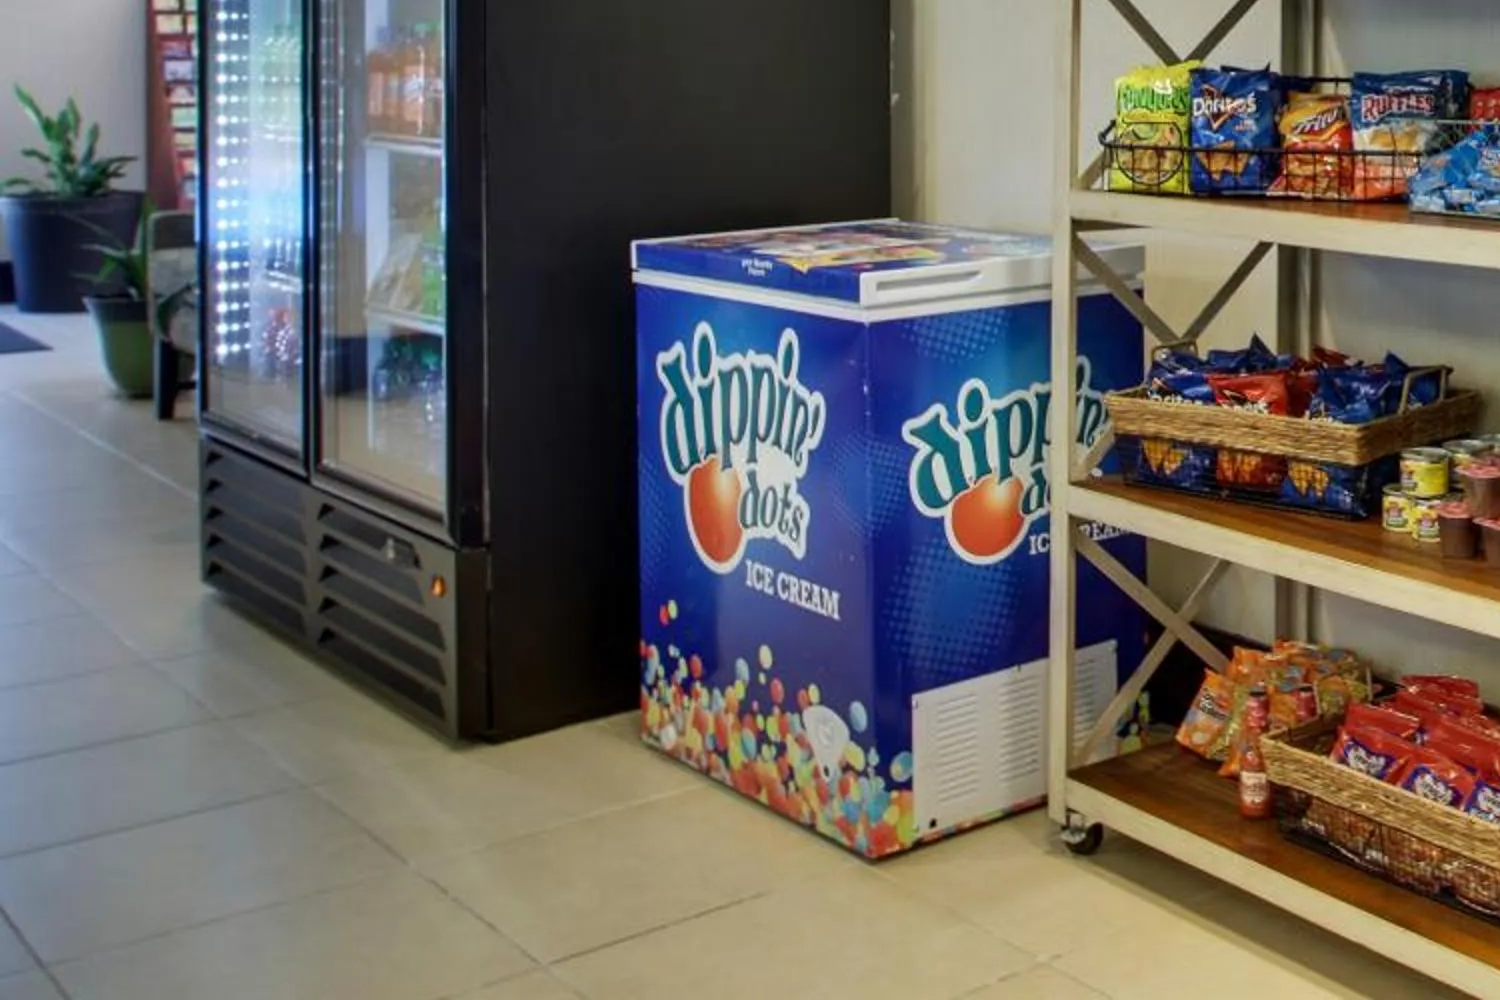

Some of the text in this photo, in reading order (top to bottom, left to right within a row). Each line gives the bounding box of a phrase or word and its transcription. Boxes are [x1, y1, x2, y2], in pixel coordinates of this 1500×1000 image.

[658, 324, 824, 480] dippin'
[739, 463, 805, 544] dots
[745, 558, 842, 622] ICE CREAM
